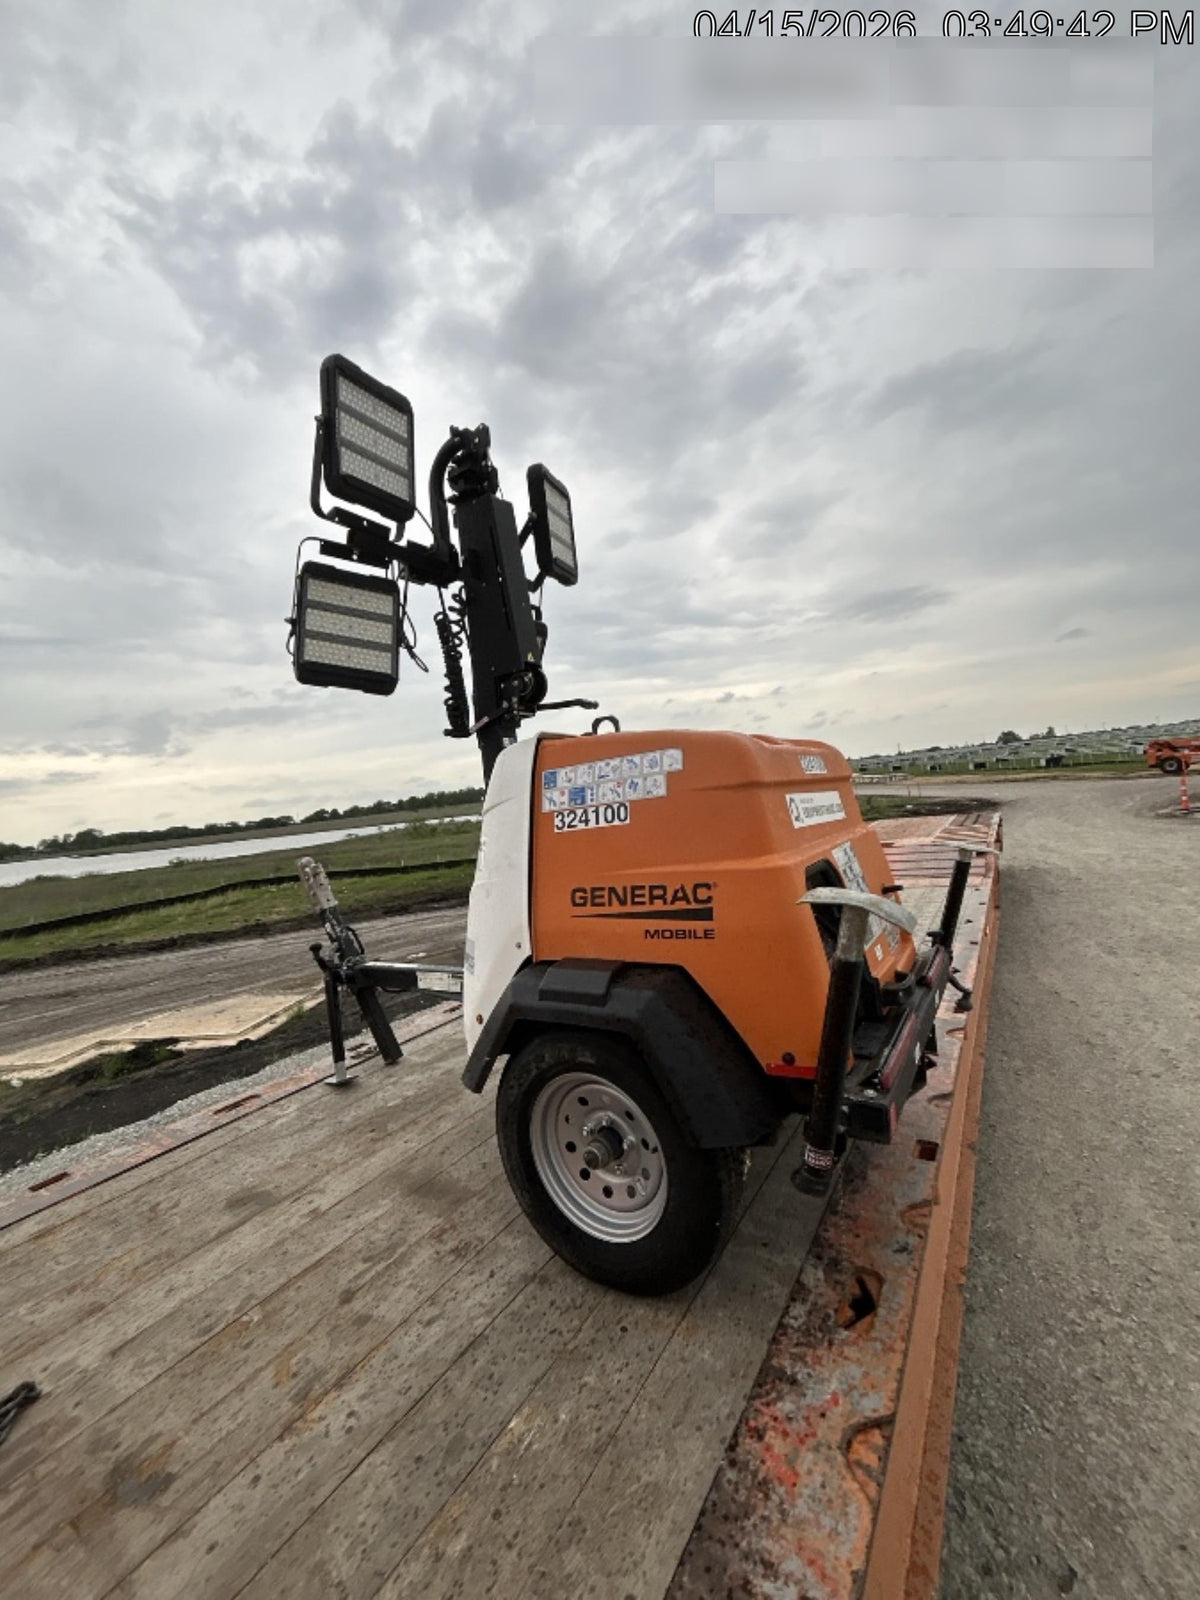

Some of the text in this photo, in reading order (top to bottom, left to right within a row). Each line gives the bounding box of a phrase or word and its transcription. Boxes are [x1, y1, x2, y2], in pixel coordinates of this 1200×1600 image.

[555, 802, 629, 831] 324100
[570, 882, 713, 907] GENERAC
[644, 928, 716, 940] MOBILE
